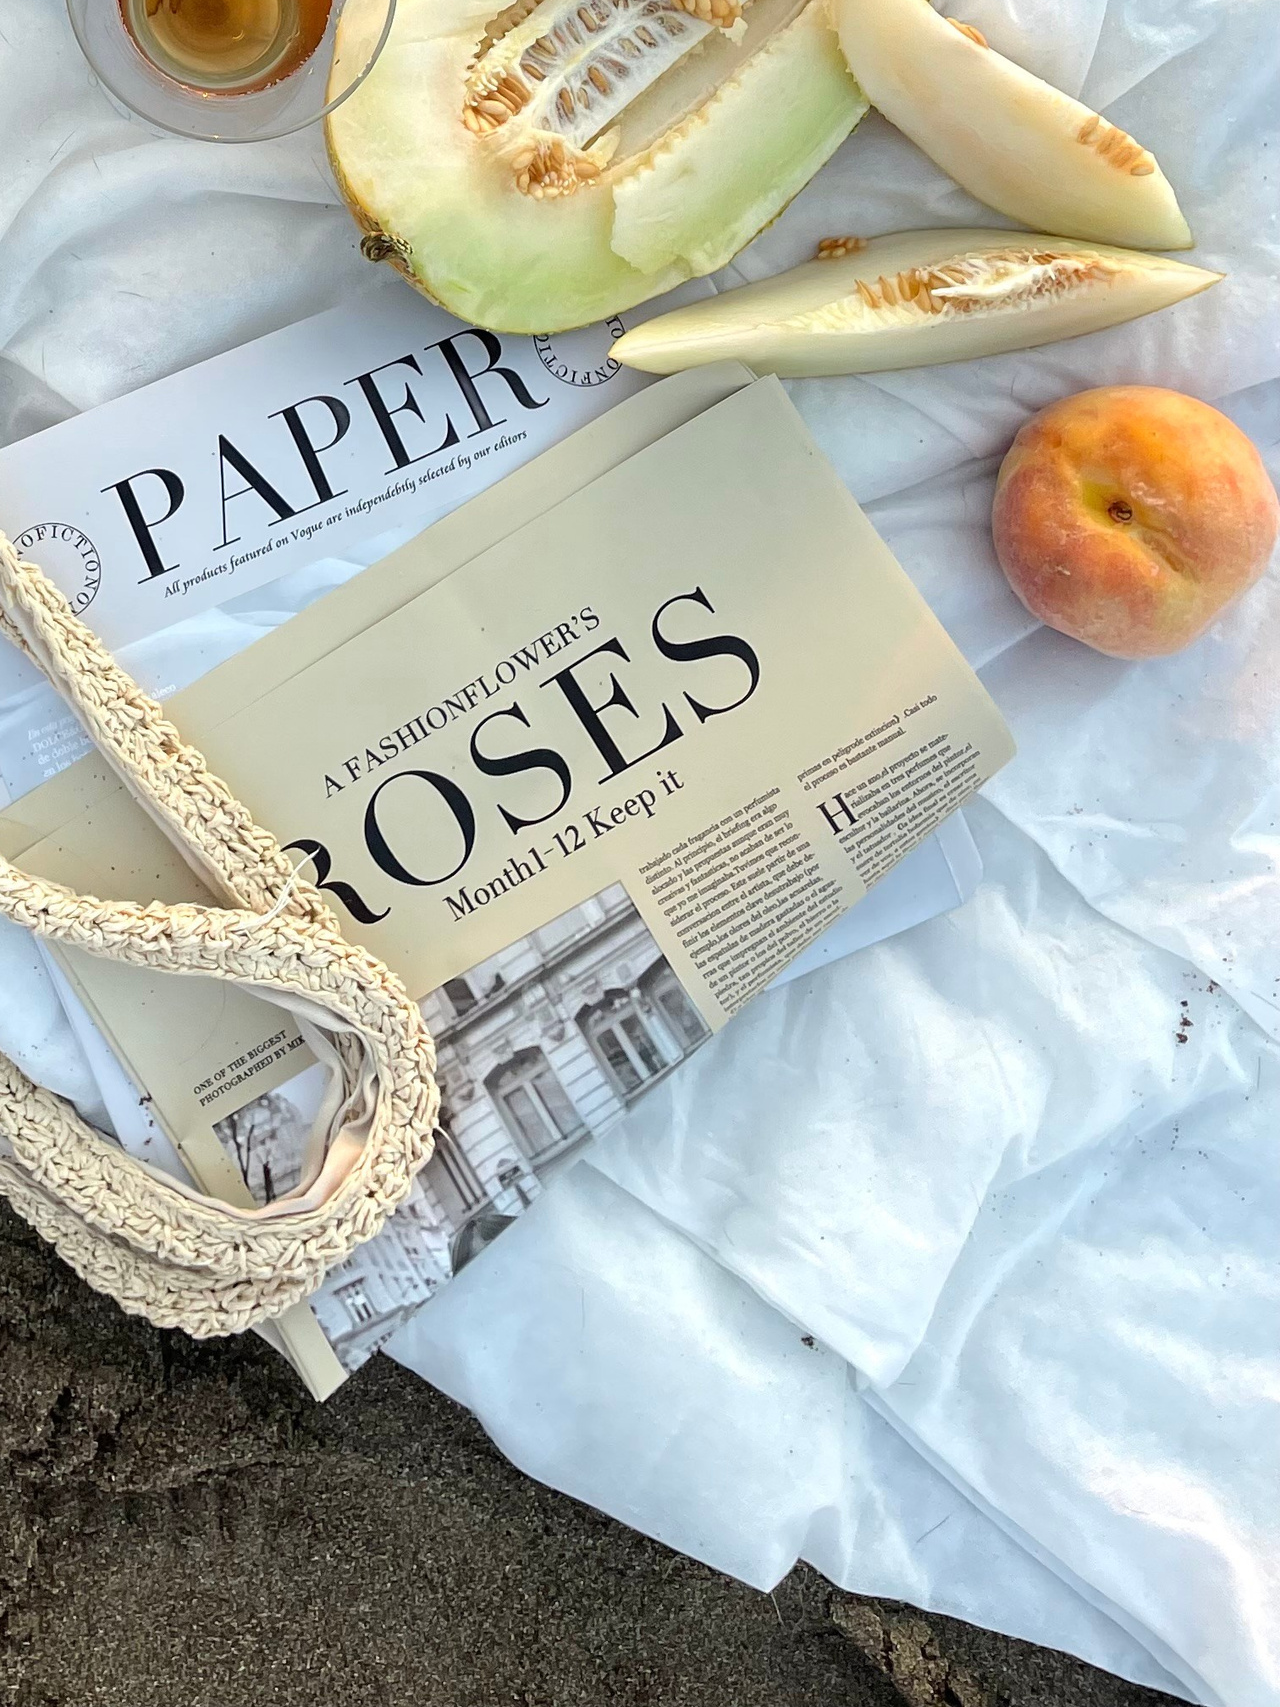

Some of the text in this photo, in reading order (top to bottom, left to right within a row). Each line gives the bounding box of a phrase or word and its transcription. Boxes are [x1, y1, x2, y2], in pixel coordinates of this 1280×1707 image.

[100, 327, 550, 584] PAPER
[165, 579, 185, 598] All
[183, 563, 228, 595] products
[230, 539, 273, 575] featured
[276, 537, 289, 548] on
[290, 521, 323, 540] Vogue
[326, 513, 342, 526] are
[418, 457, 456, 485] selected
[457, 454, 471, 469] by
[474, 446, 491, 460] our
[494, 431, 527, 451] editors
[797, 763, 822, 783] primas
[919, 695, 938, 708] todo
[811, 768, 839, 789] proceso
[845, 745, 877, 766] bastante
[888, 751, 920, 774] proyecto
[325, 775, 345, 798] A
[582, 790, 656, 839] Keep
[656, 770, 684, 795] it
[850, 788, 881, 809] rializaba
[890, 773, 905, 785] tres
[905, 753, 938, 778] perfumes
[937, 745, 951, 757] que
[857, 797, 890, 820] evocaban
[888, 789, 901, 799] los
[901, 770, 932, 792] entornos
[931, 761, 944, 773] del
[913, 782, 936, 799] Ahora,
[638, 787, 781, 875] trabajado cada fragancia con un perfumista
[681, 867, 694, 877] las
[693, 844, 732, 872] propuestas
[757, 819, 774, 832] eran
[773, 809, 790, 823] muy
[682, 841, 716, 865] principio,
[750, 812, 763, 823] era
[762, 803, 778, 815] algo
[739, 839, 765, 858] acaban
[773, 827, 785, 837] ser
[843, 844, 856, 854] las
[855, 812, 906, 849] personalidades
[906, 803, 917, 814] del
[663, 905, 678, 917] que
[676, 900, 687, 910] yo
[686, 893, 699, 903] me
[764, 845, 779, 857] que
[670, 909, 694, 927] siderar
[730, 878, 747, 891] Este
[747, 867, 766, 882] suele
[765, 855, 786, 873] partir
[795, 841, 811, 853] una
[721, 897, 740, 911] entre
[747, 879, 773, 896] artista,
[772, 870, 786, 882] que
[786, 860, 804, 873] debe
[694, 960, 707, 970] las
[748, 918, 776, 937] madera
[775, 899, 805, 922] gastadas
[697, 929, 710, 939] los
[710, 908, 746, 932] elementos
[745, 897, 764, 911] clave
[702, 968, 718, 980] rras
[717, 959, 731, 971] que
[776, 910, 807, 934] ambiente
[807, 901, 818, 912] del
[818, 886, 843, 905] estudio
[728, 919, 751, 936] olores
[750, 910, 763, 922] del
[193, 1030, 287, 1095] ONE OF THE BIGGEST
[199, 1055, 274, 1107] PHOTOGRAPHED
[273, 1046, 286, 1059] BY
